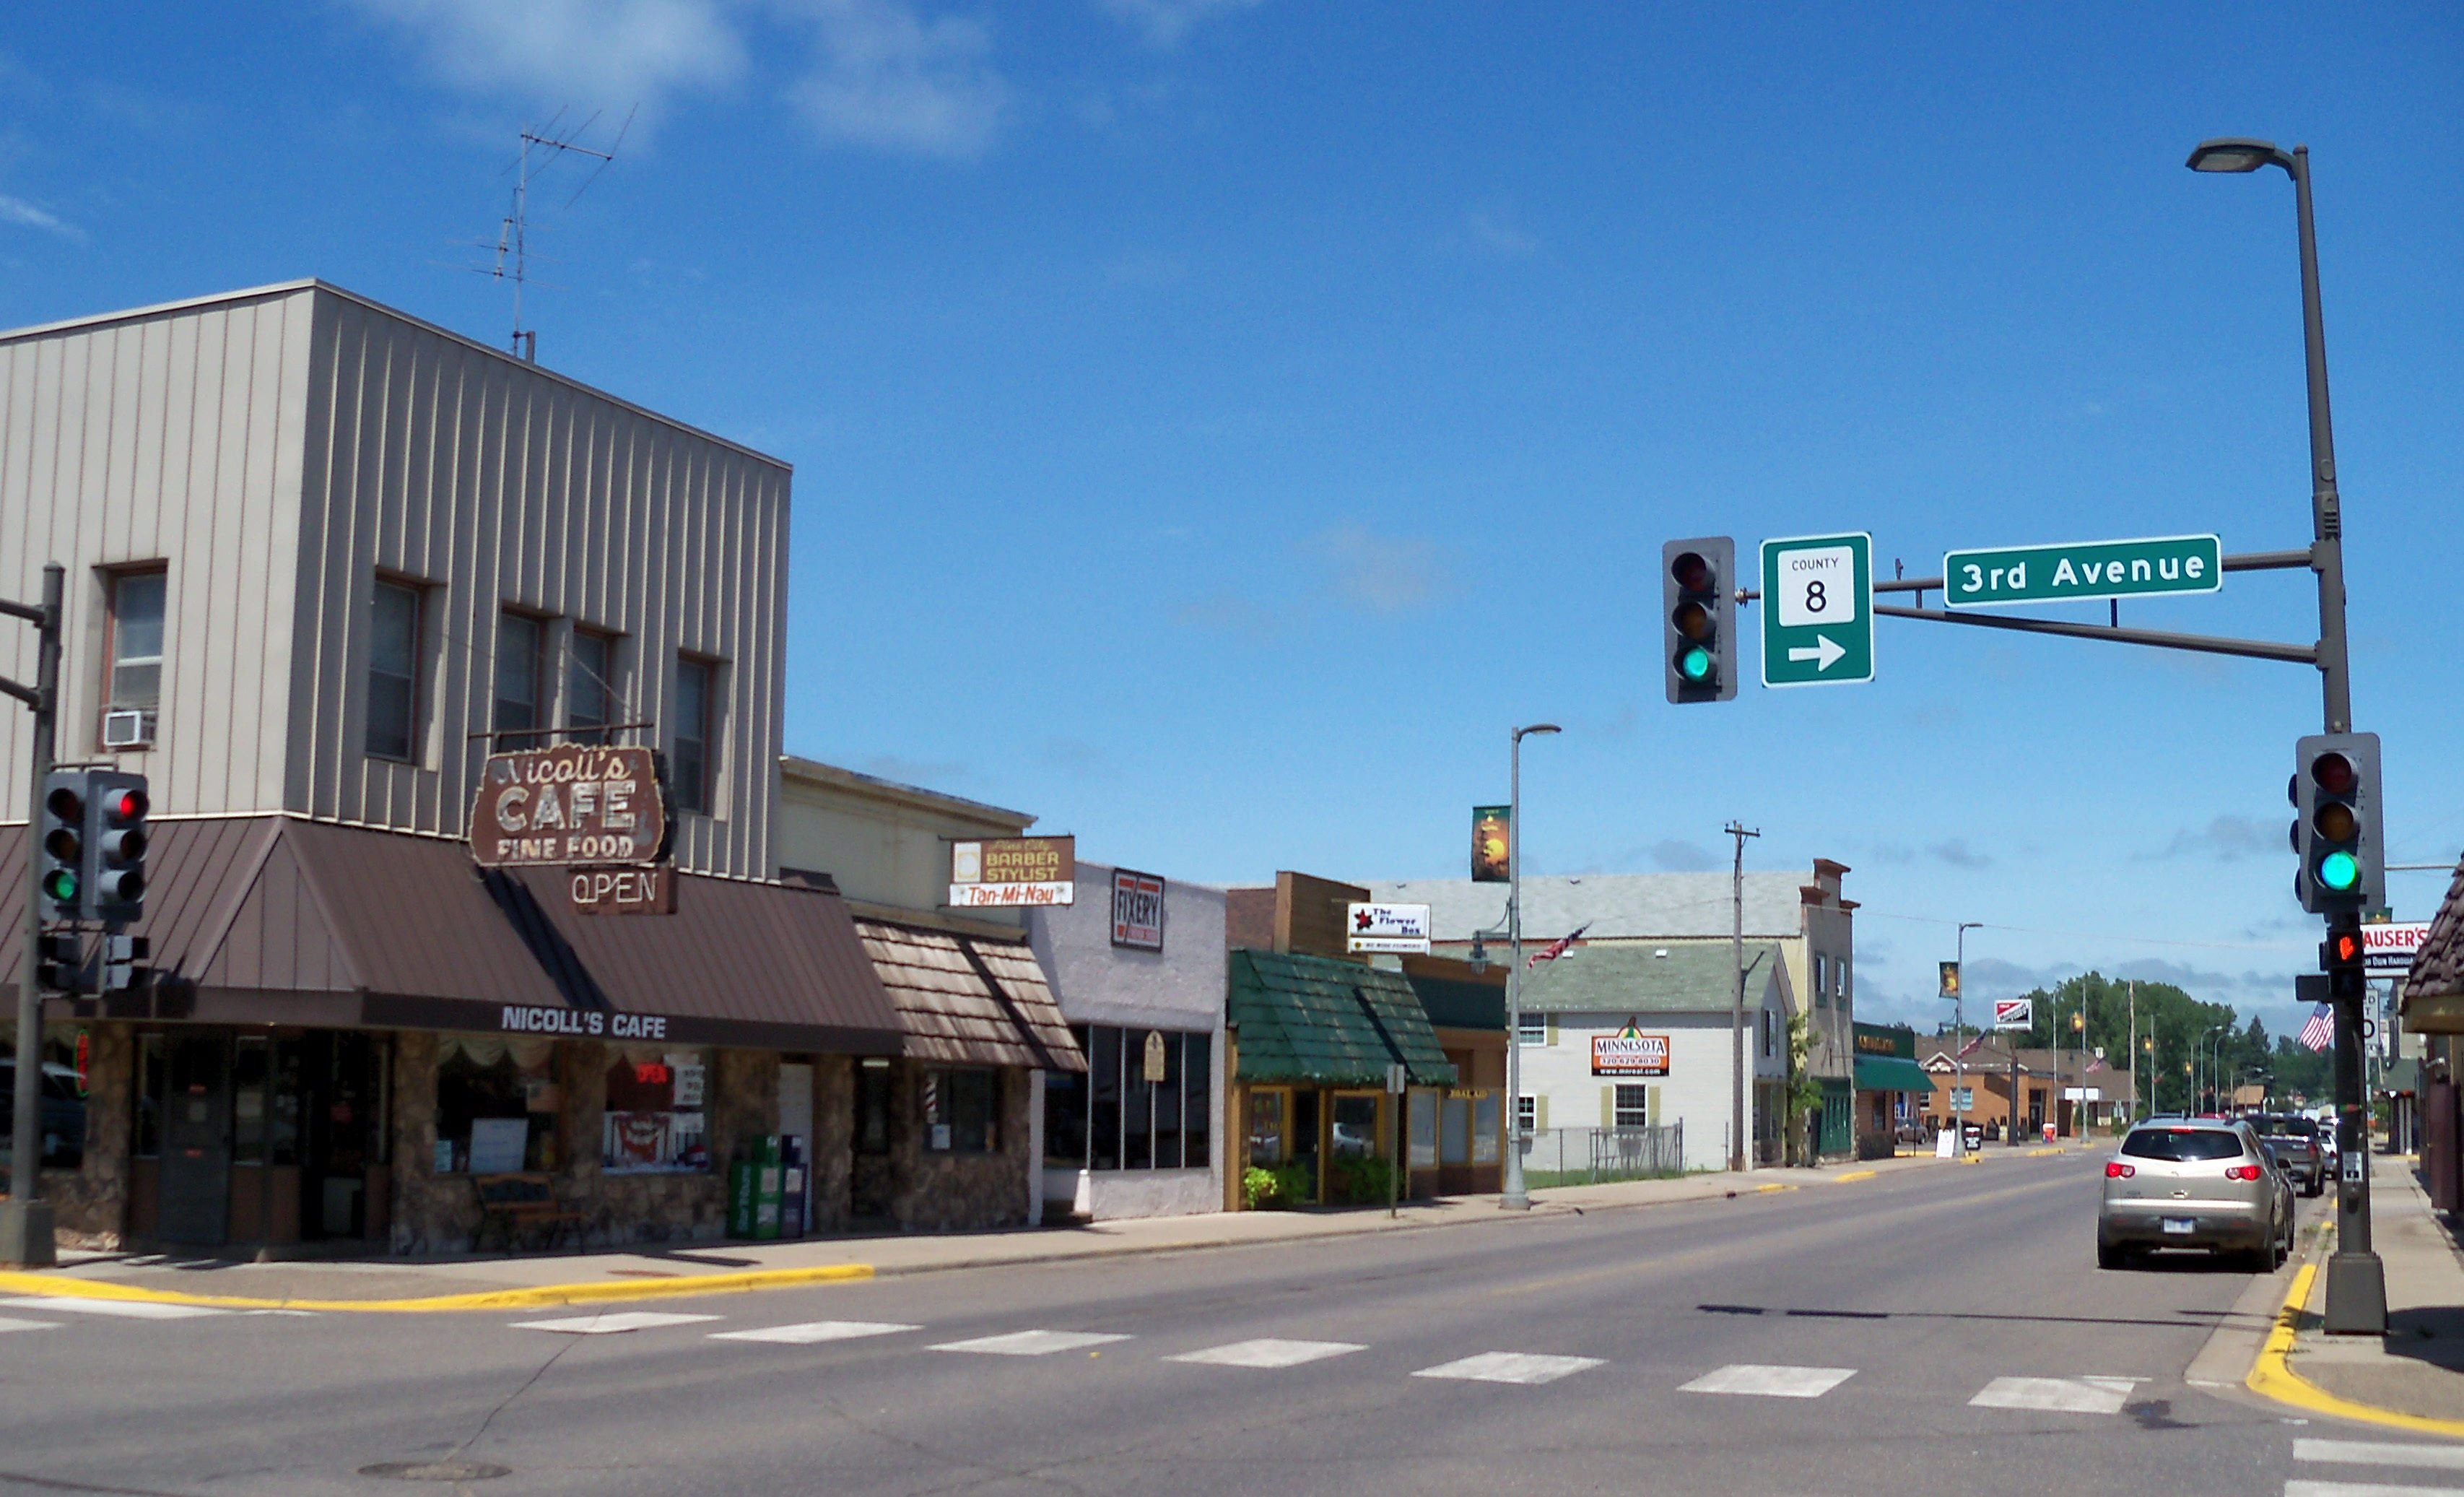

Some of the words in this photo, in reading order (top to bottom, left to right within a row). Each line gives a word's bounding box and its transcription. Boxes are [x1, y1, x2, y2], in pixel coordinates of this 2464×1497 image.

[1792, 557, 1839, 571] COUNTY
[1962, 561, 2026, 592] 3rd
[2052, 555, 2205, 587] Avenue
[1806, 581, 1827, 613] 8
[495, 780, 636, 831] CAFE
[497, 837, 557, 859] FINE
[567, 836, 634, 858] FOOD
[986, 851, 1059, 867] BARBER
[986, 867, 1058, 882] STYLIST
[571, 872, 658, 903] OPEN
[2363, 927, 2428, 947] AUSER'S
[501, 1005, 604, 1036] NICOLL'S
[611, 1013, 666, 1039] CAFE
[1596, 1040, 1665, 1054] MINNESOTA
